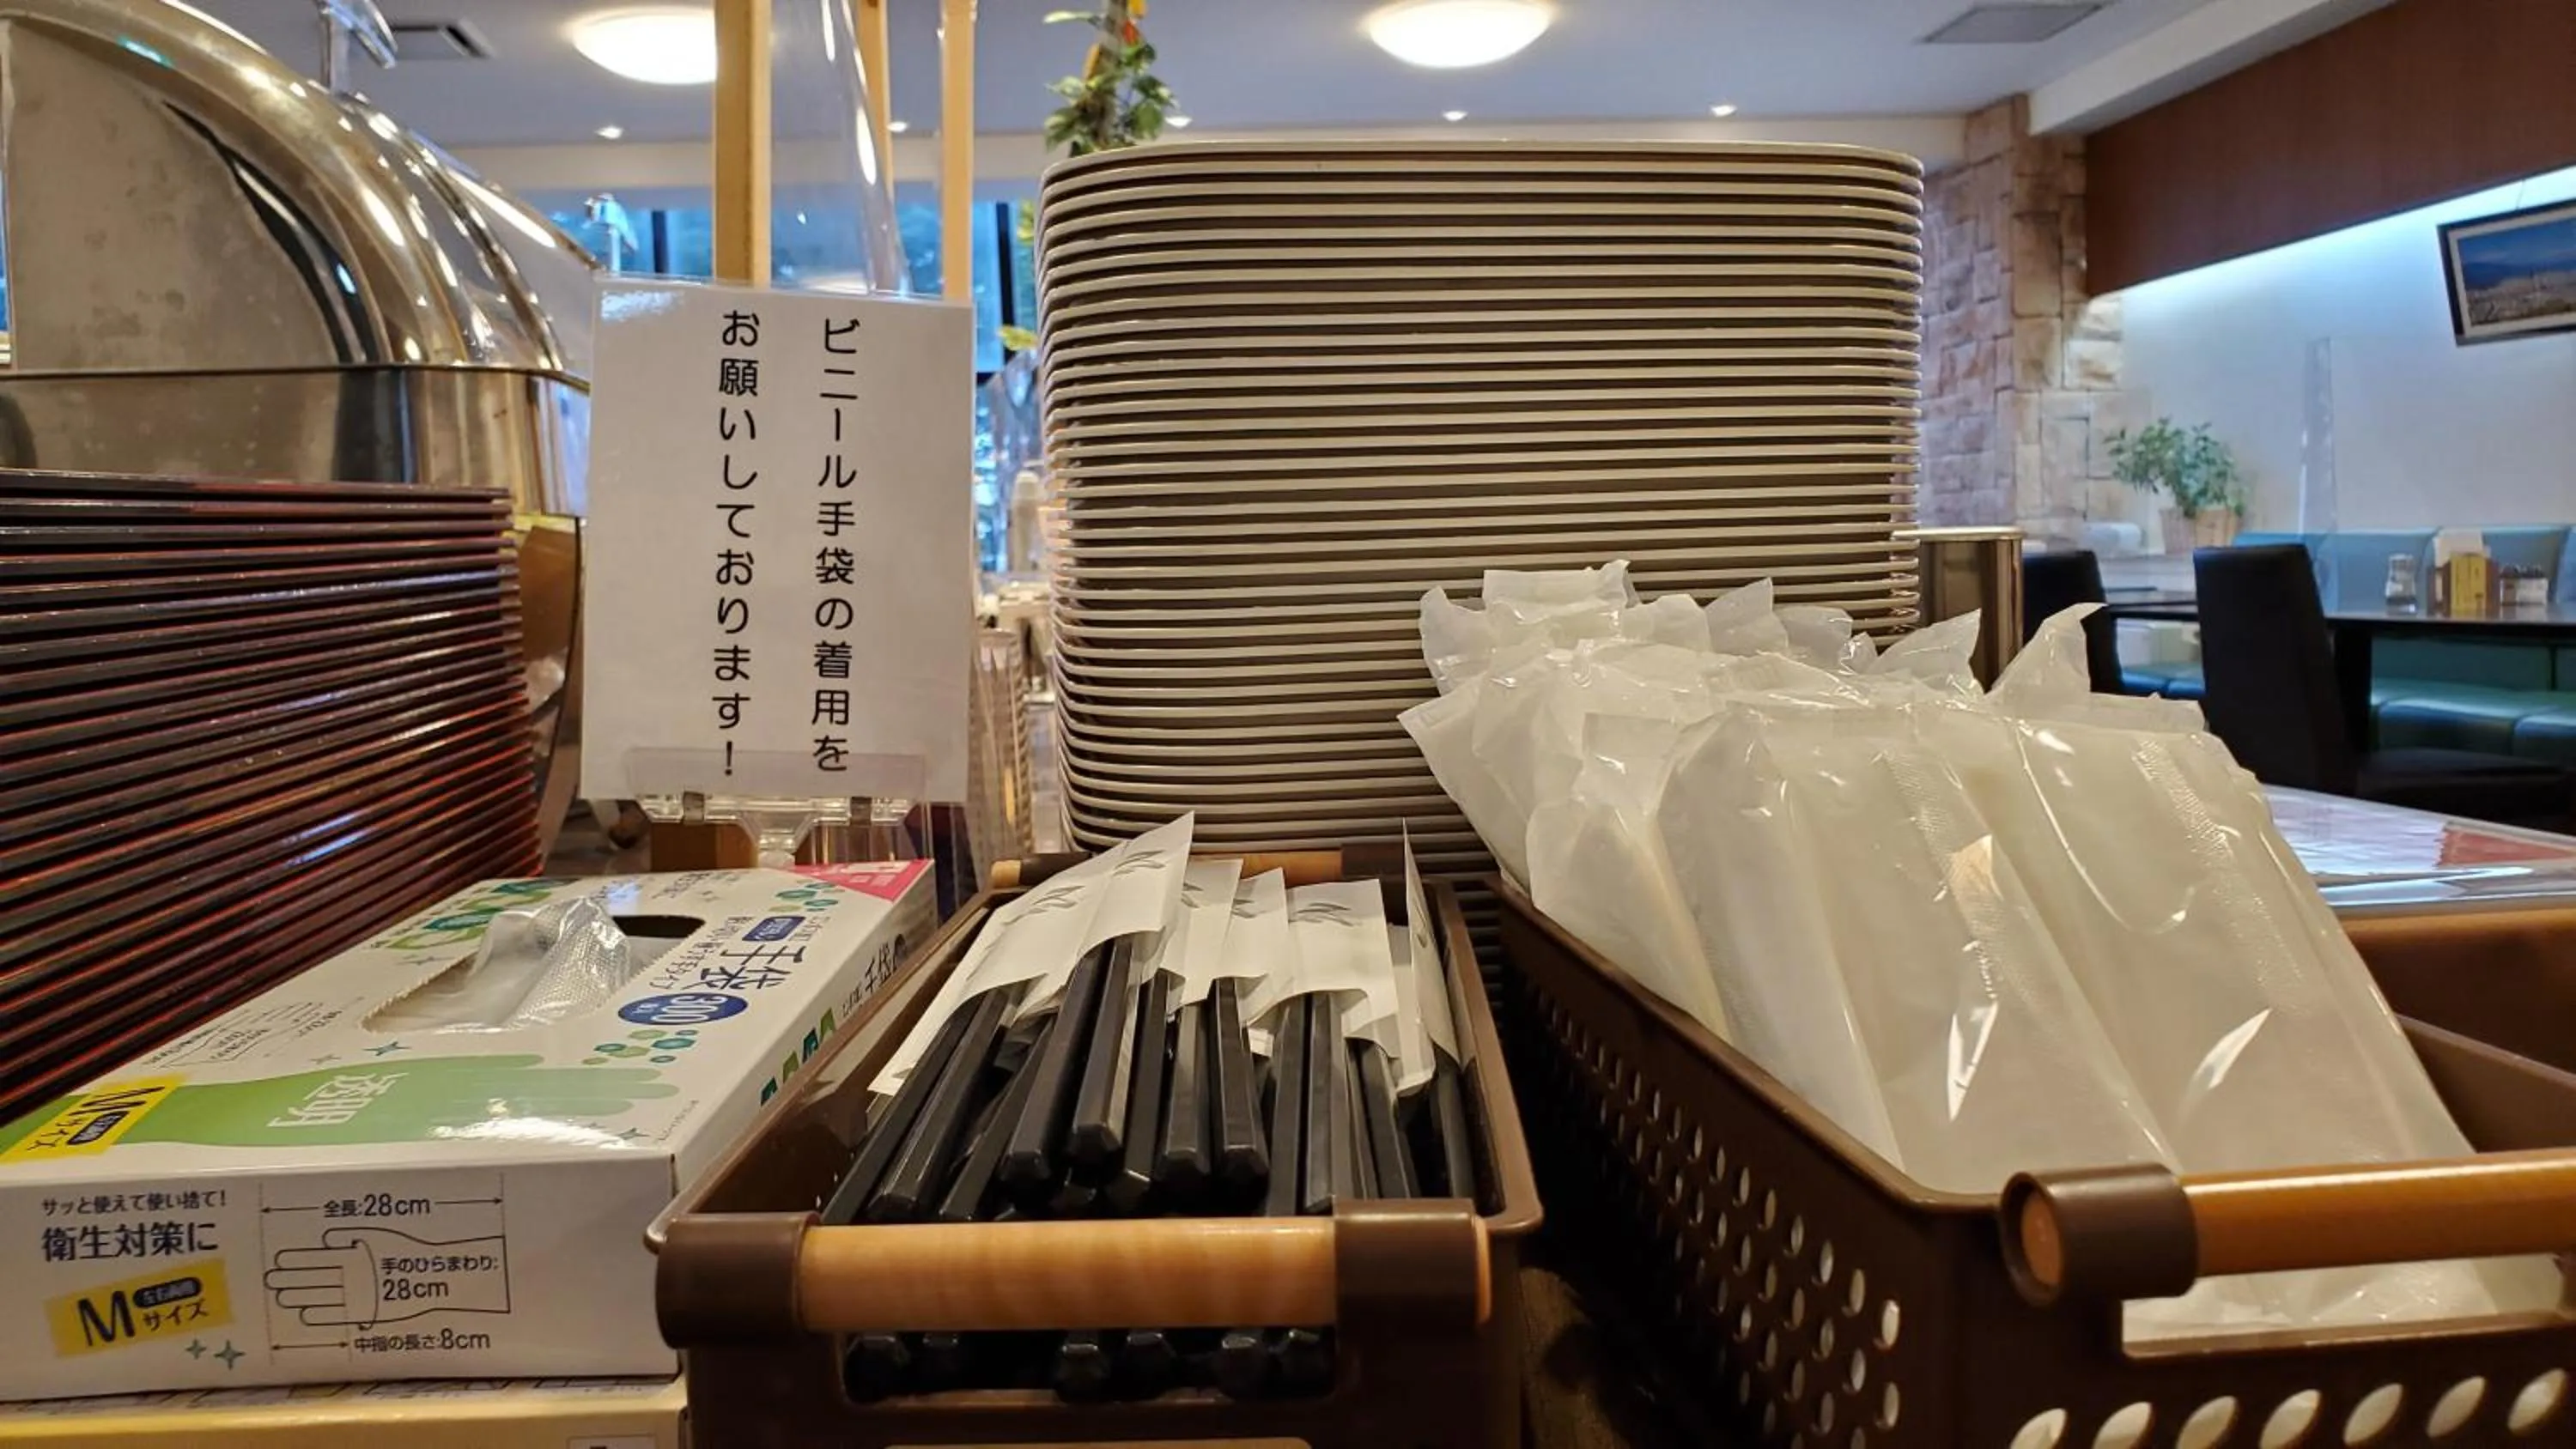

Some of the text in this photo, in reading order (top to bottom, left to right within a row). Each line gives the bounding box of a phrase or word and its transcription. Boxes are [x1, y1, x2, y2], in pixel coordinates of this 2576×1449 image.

[712, 310, 760, 776] お願いしております!
[811, 318, 860, 772] ビニール手袋の着用を
[680, 943, 807, 991] 手袋
[650, 996, 728, 1023] 300
[266, 1071, 410, 1127] 透明
[41, 1189, 226, 1216] サッと使えて使い捨て!
[41, 1222, 219, 1263] 衛生対策に
[382, 1277, 449, 1301] 28cm
[77, 1290, 136, 1347] M
[143, 1297, 210, 1331] サイズ
